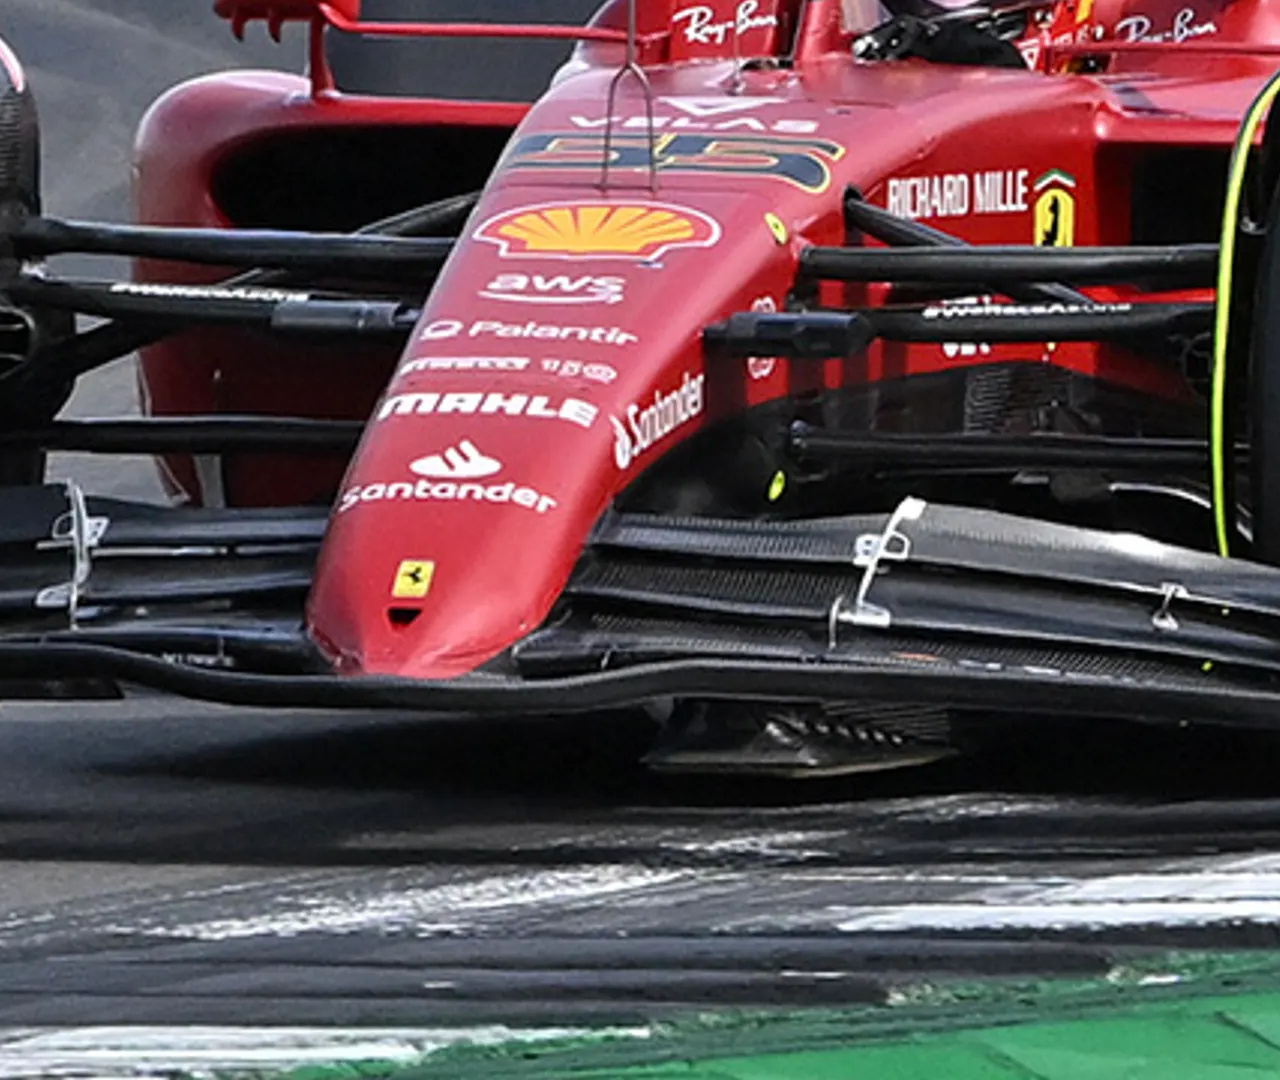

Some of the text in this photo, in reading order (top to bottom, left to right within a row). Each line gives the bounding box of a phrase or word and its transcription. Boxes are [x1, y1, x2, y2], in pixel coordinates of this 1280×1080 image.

[505, 132, 846, 195] 55
[887, 168, 1029, 219] RICHARD MILLE
[486, 272, 625, 296] aws
[466, 320, 639, 346] Palantir
[377, 391, 598, 428] MAHLE
[628, 372, 706, 453] Santander
[340, 481, 558, 513] Santander
